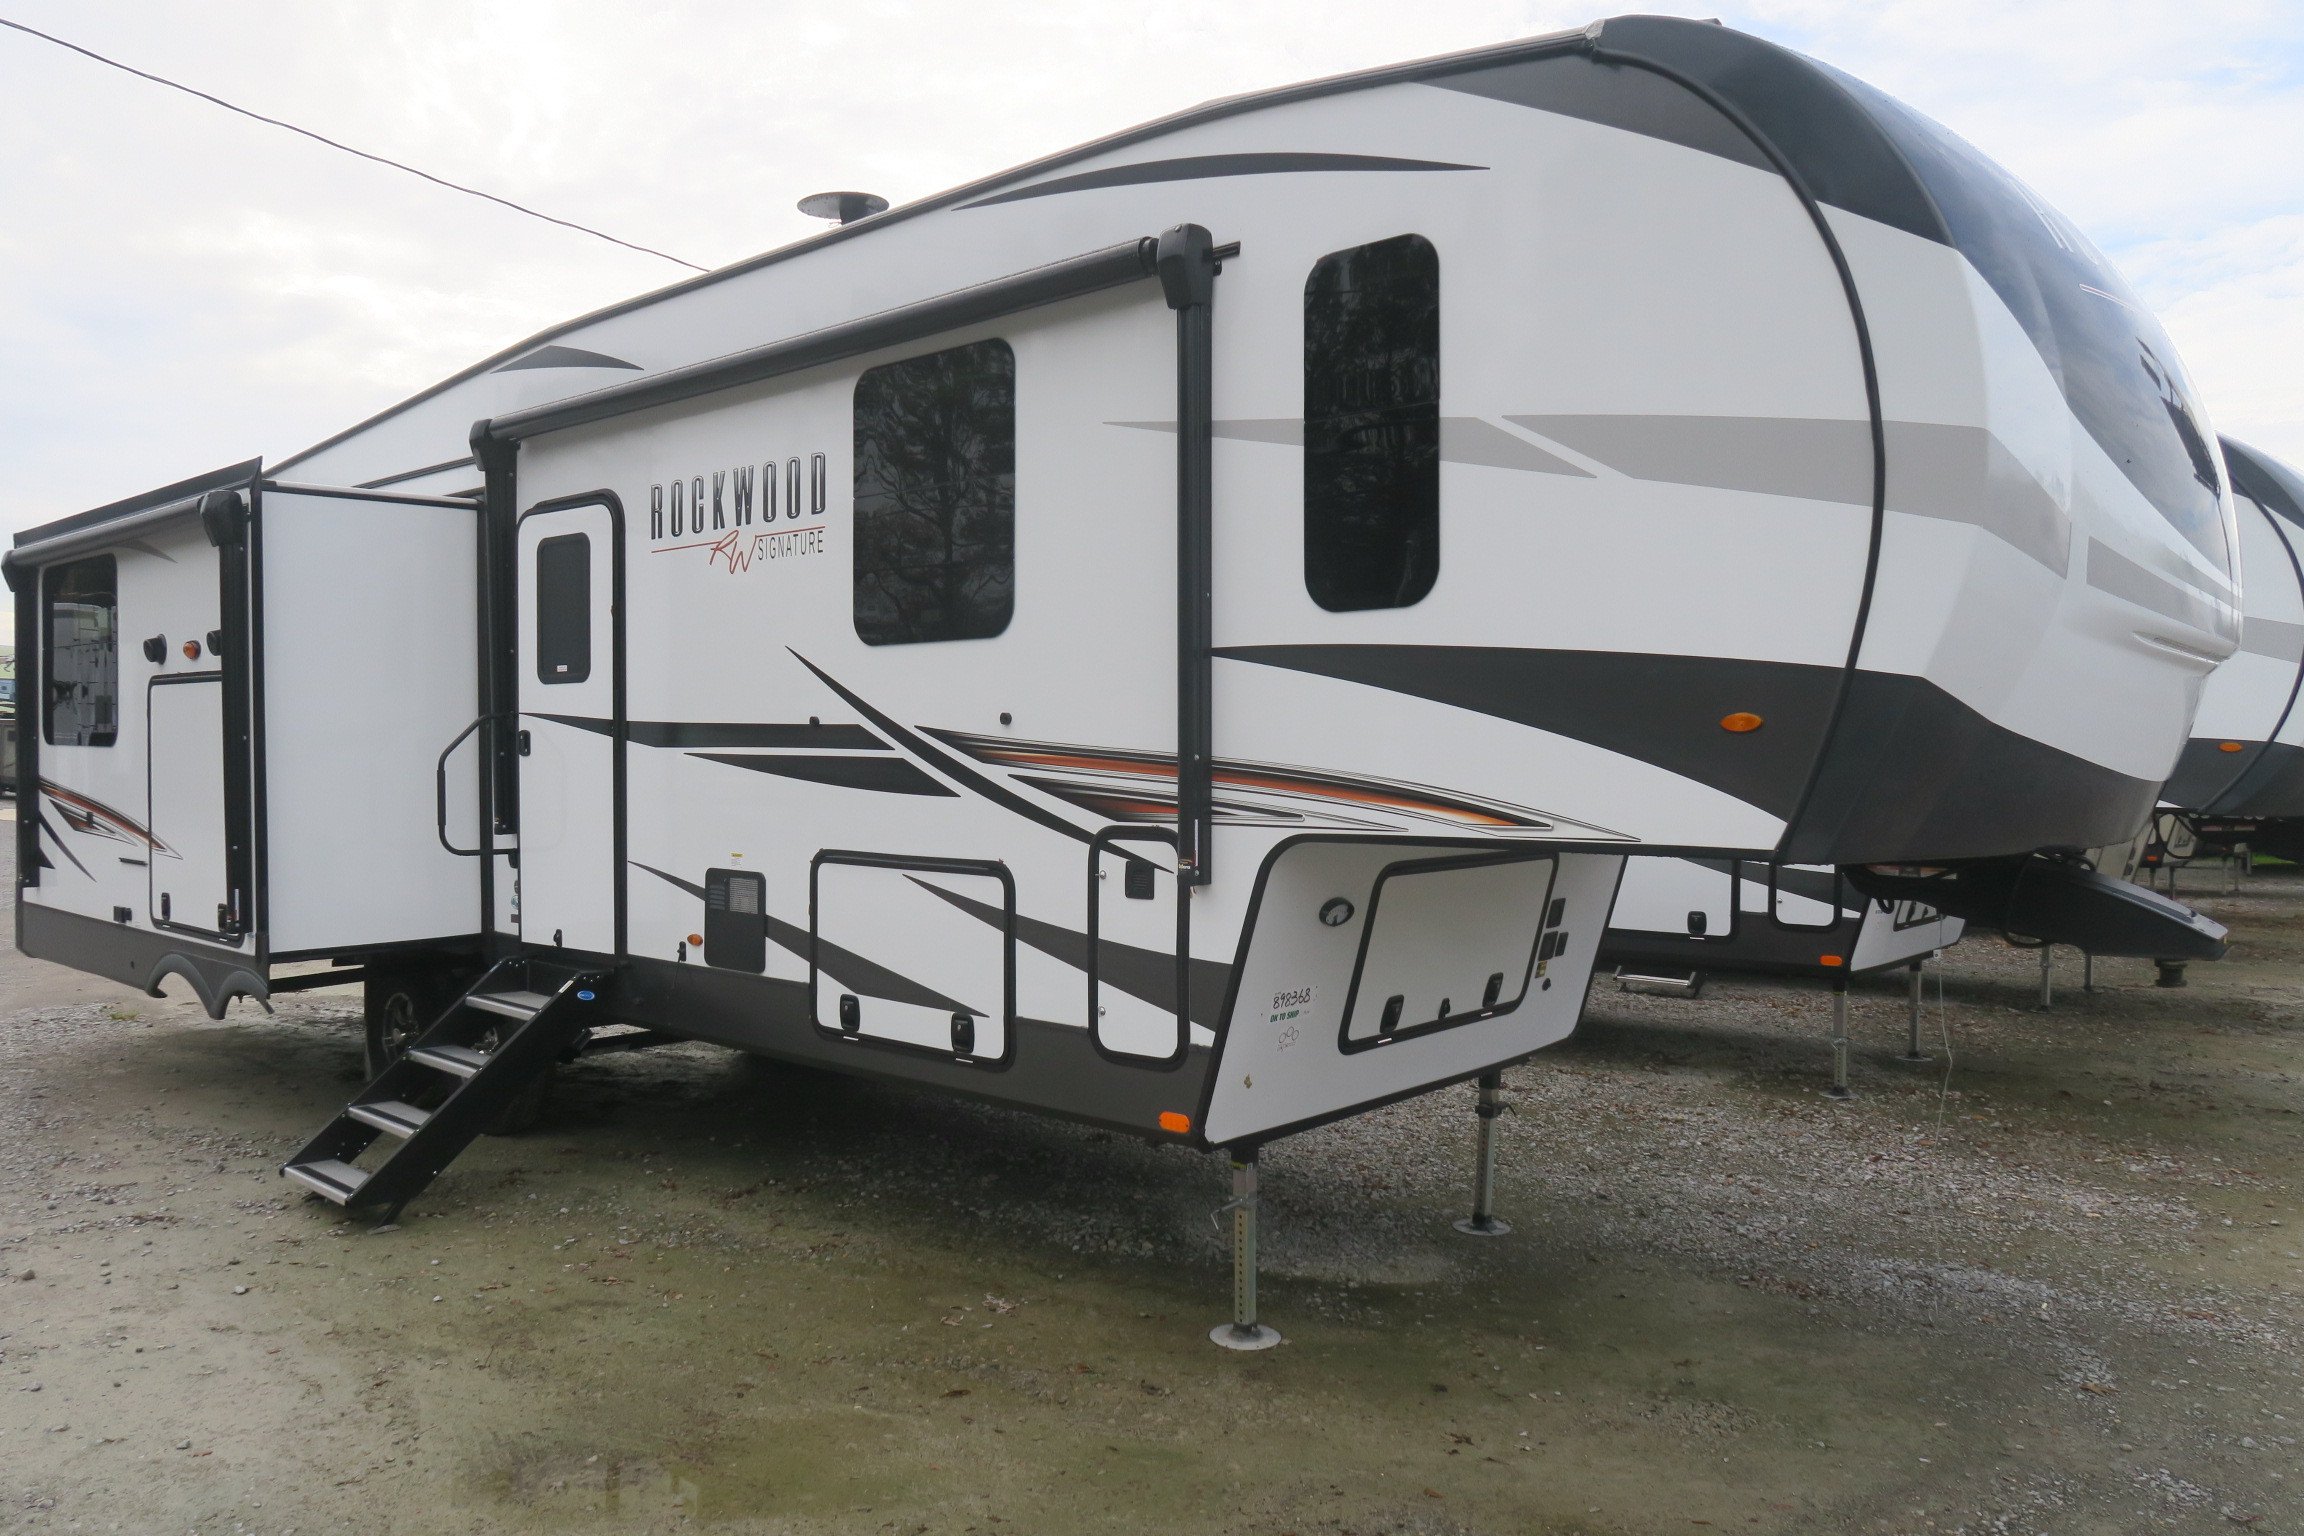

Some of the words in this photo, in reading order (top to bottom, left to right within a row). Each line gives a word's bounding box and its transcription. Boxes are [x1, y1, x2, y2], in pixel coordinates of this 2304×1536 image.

[651, 451, 826, 540] ROCKWOOD
[757, 530, 824, 561] SIGNATURE
[1273, 988, 1311, 1009] 898368
